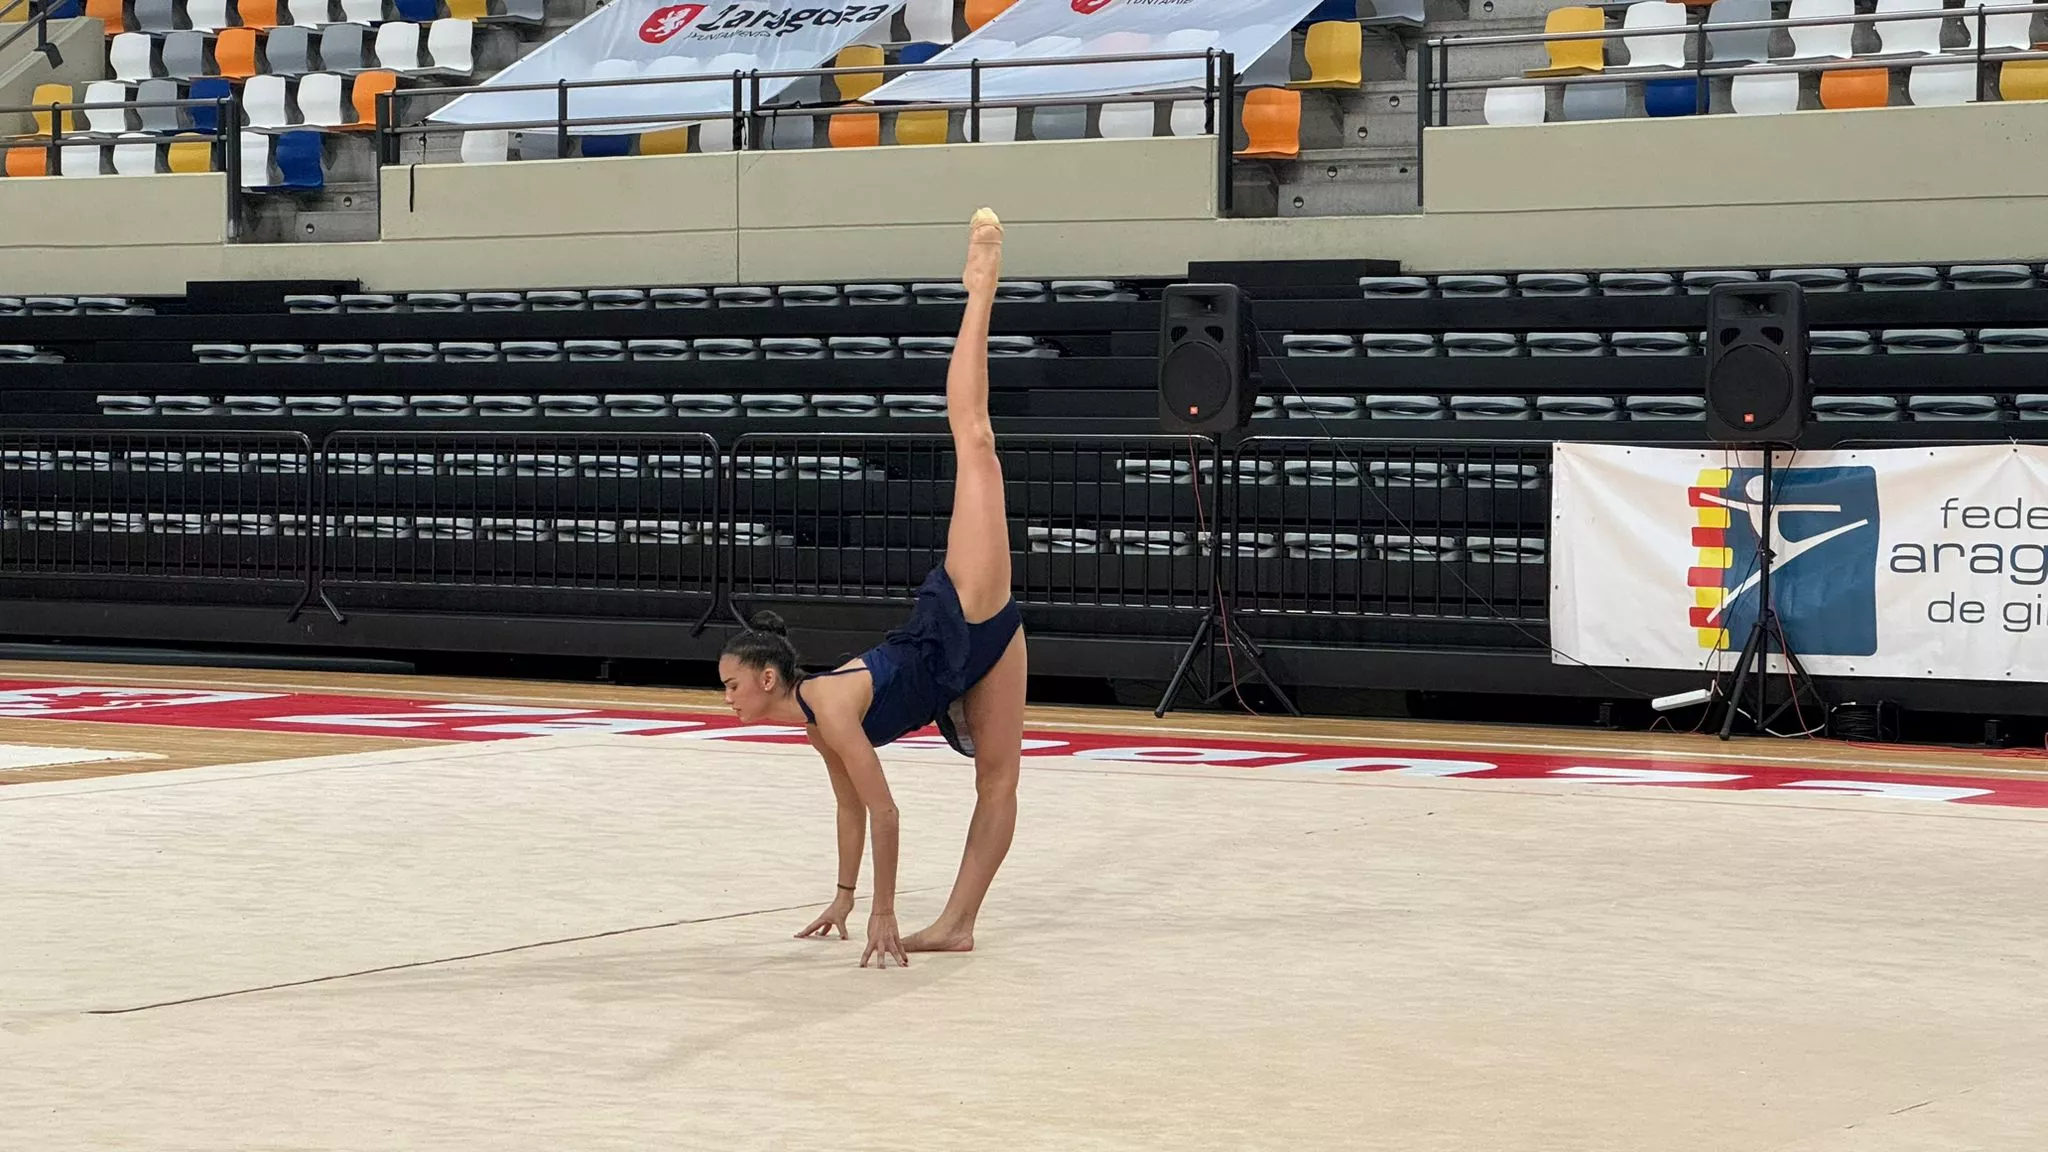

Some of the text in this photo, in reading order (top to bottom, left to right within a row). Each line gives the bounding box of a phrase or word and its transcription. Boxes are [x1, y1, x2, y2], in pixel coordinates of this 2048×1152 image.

[1940, 497, 2048, 530] fede
[1890, 543, 2048, 585] arag
[1927, 592, 2048, 633] de gi
